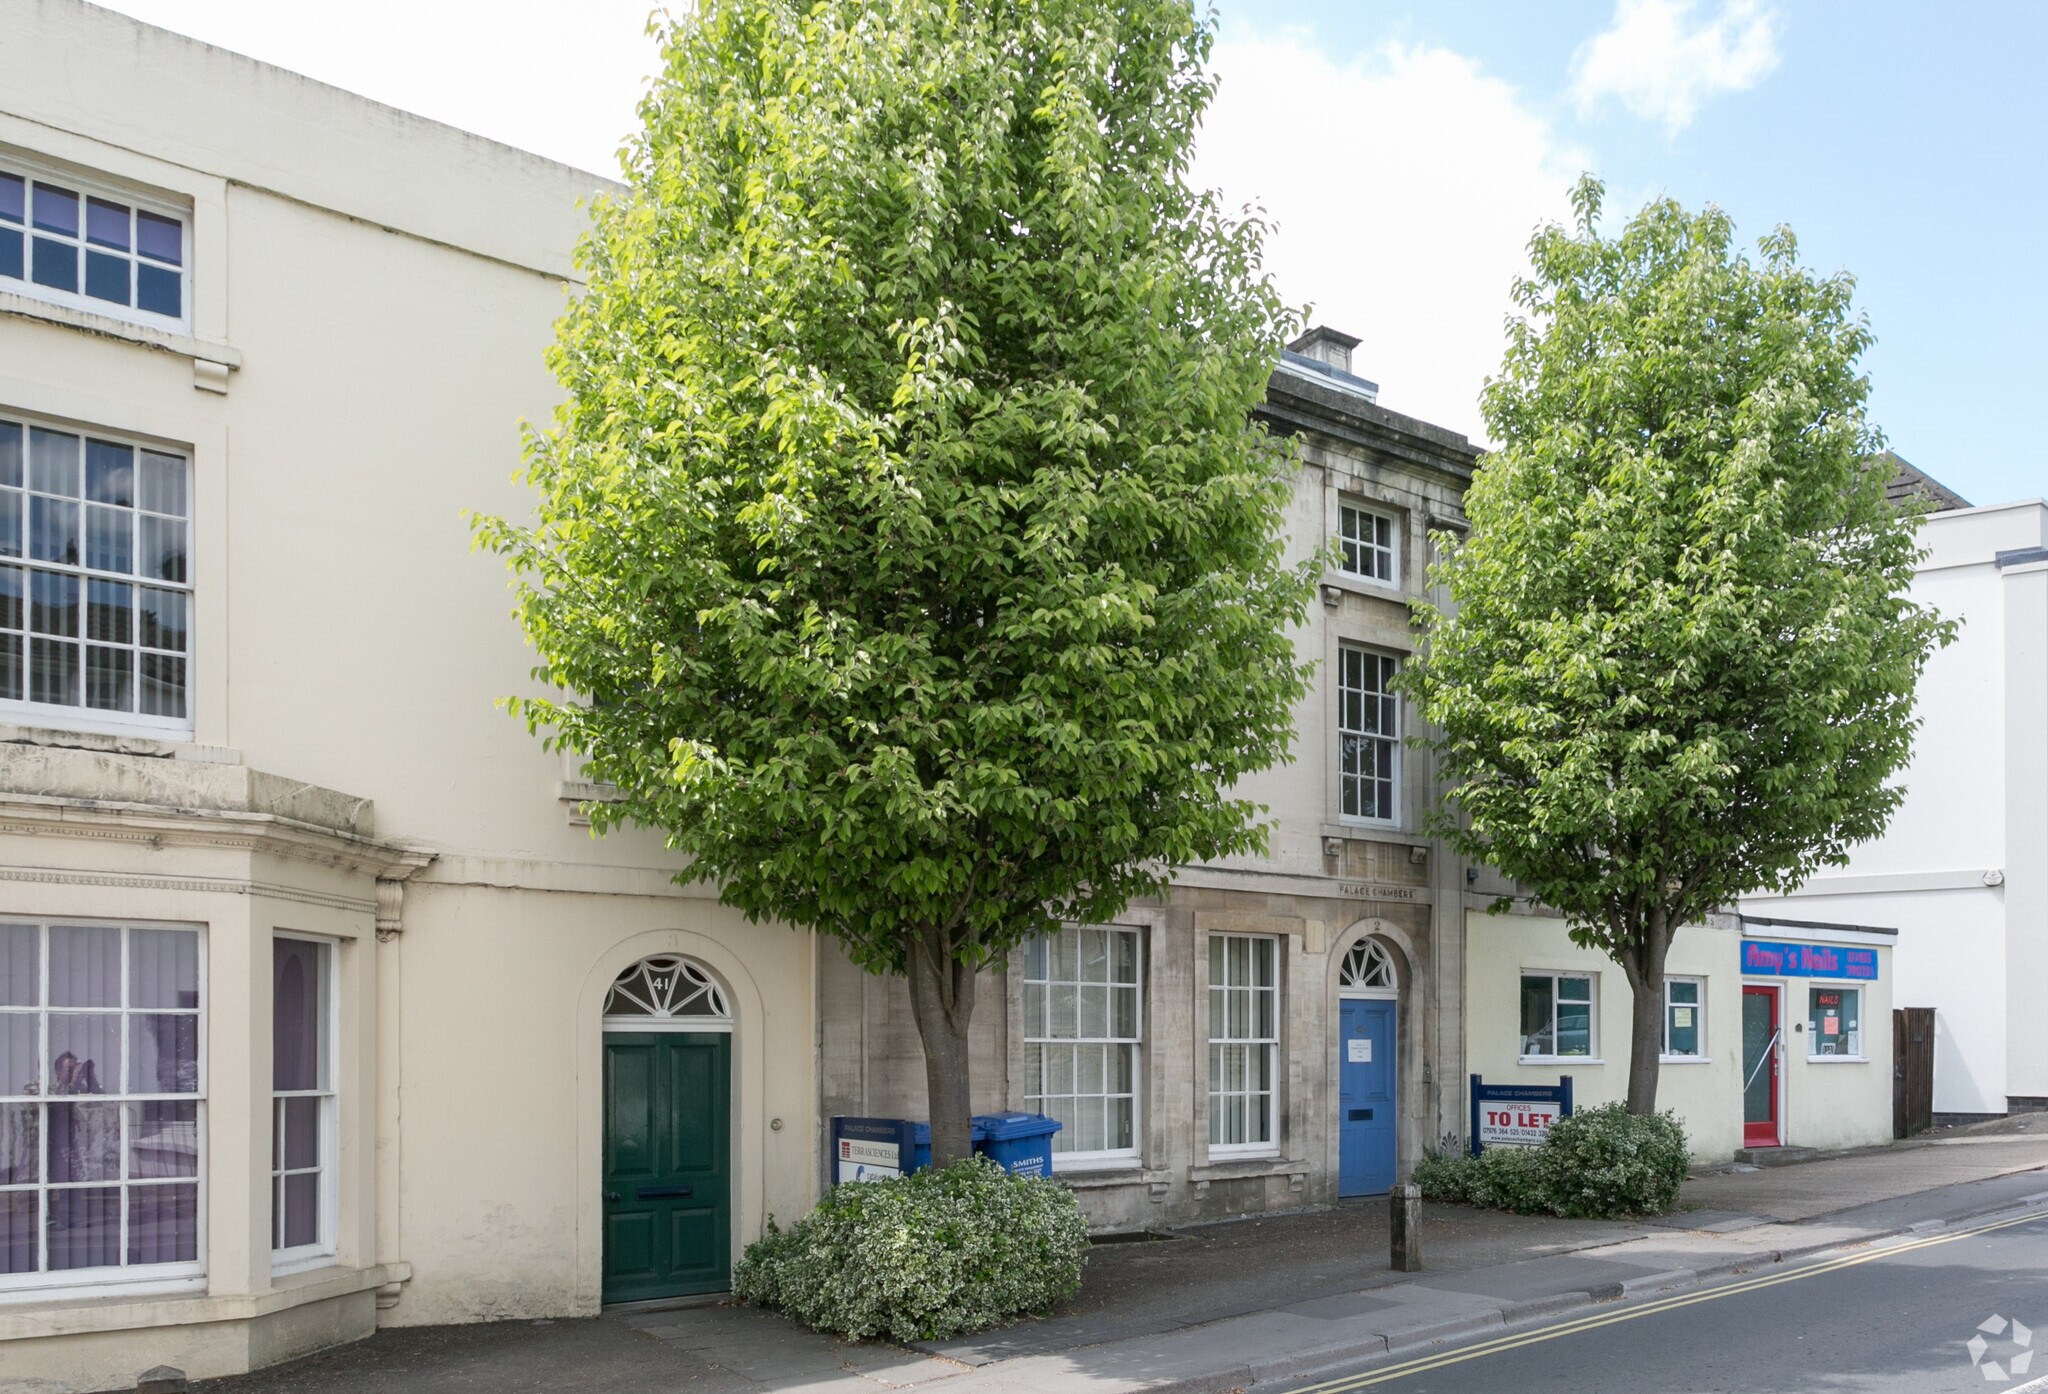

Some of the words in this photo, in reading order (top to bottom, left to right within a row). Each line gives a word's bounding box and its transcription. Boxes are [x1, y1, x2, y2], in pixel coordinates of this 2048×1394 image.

[1339, 885, 1370, 896] PALACE
[1372, 888, 1413, 899] CHAMBERS
[1374, 921, 1380, 931] 2
[1747, 944, 1797, 974] Amy's
[1801, 948, 1838, 971] Nails
[653, 977, 669, 990] 41
[1819, 995, 1839, 1005] NAILS
[1506, 1104, 1531, 1112] OFFICES
[1487, 1111, 1511, 1127] TO
[1517, 1113, 1552, 1128] LET
[865, 1126, 895, 1135] CHAMBERS
[851, 1146, 891, 1159] TERRASCIENCES
[1013, 1156, 1044, 1167] SMITHS
